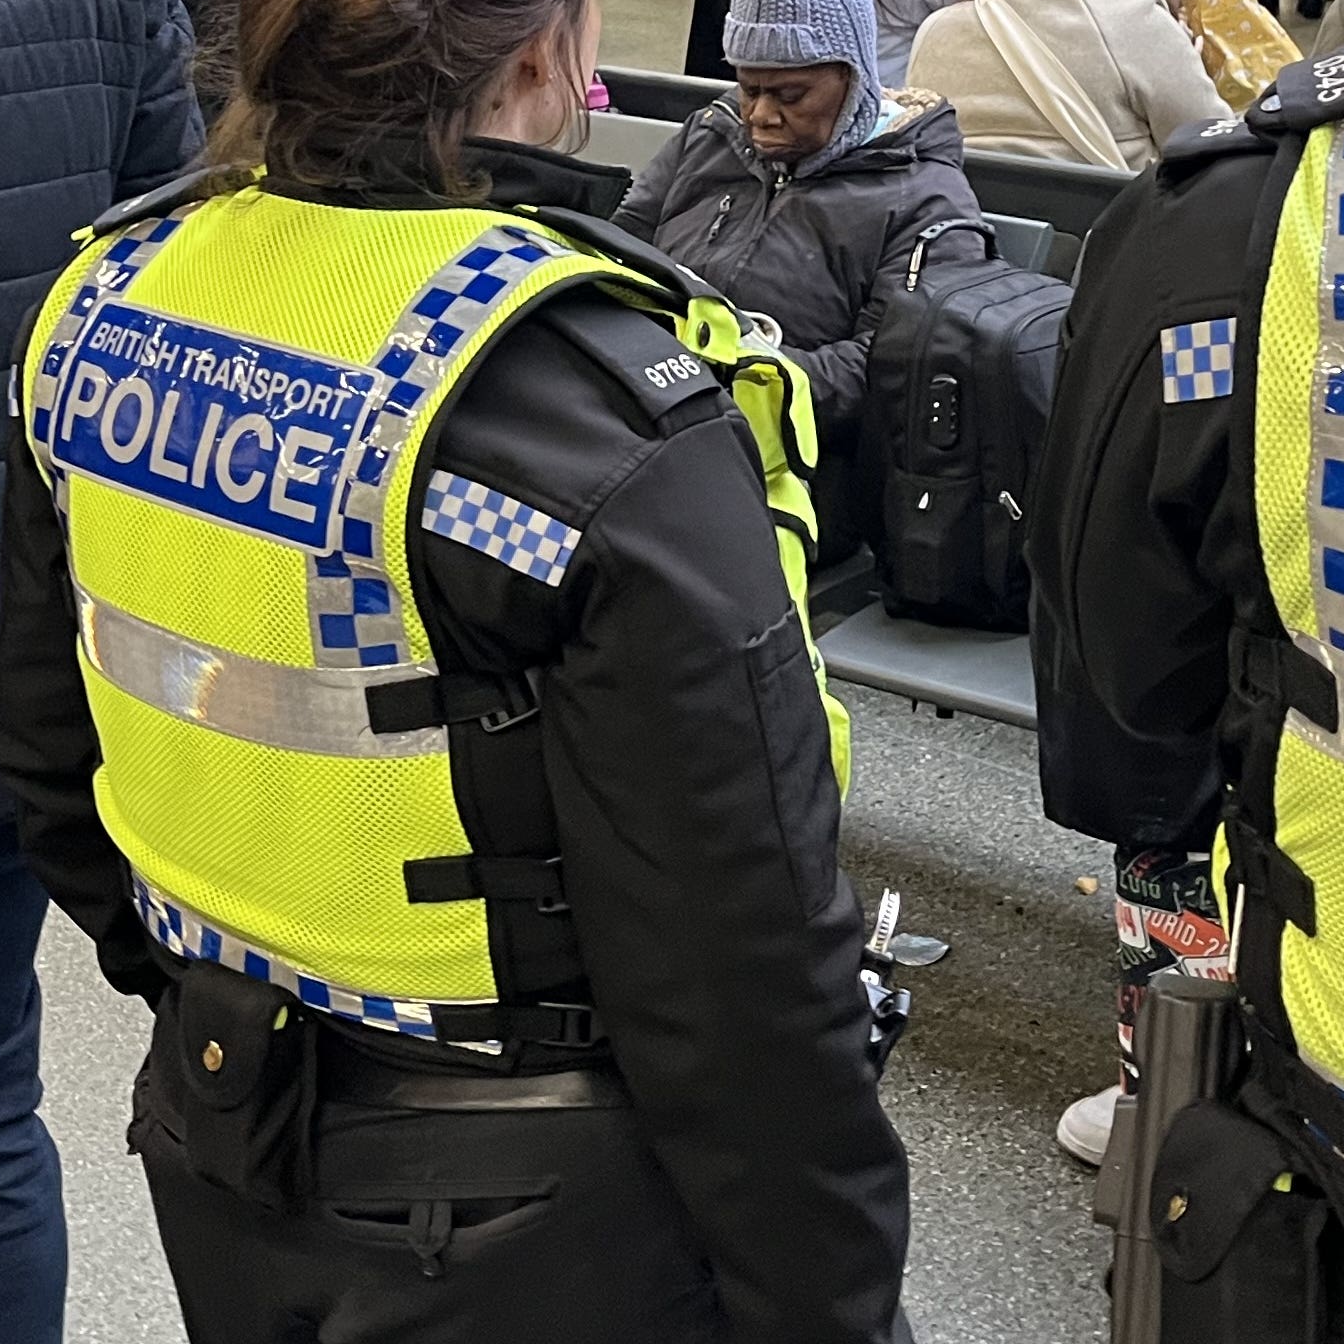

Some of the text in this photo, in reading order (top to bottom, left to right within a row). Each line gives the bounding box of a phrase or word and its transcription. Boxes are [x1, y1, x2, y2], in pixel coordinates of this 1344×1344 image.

[89, 322, 353, 420] BRITISH TRANSPORT
[644, 353, 701, 389] 9766
[62, 362, 334, 524] POLICE
